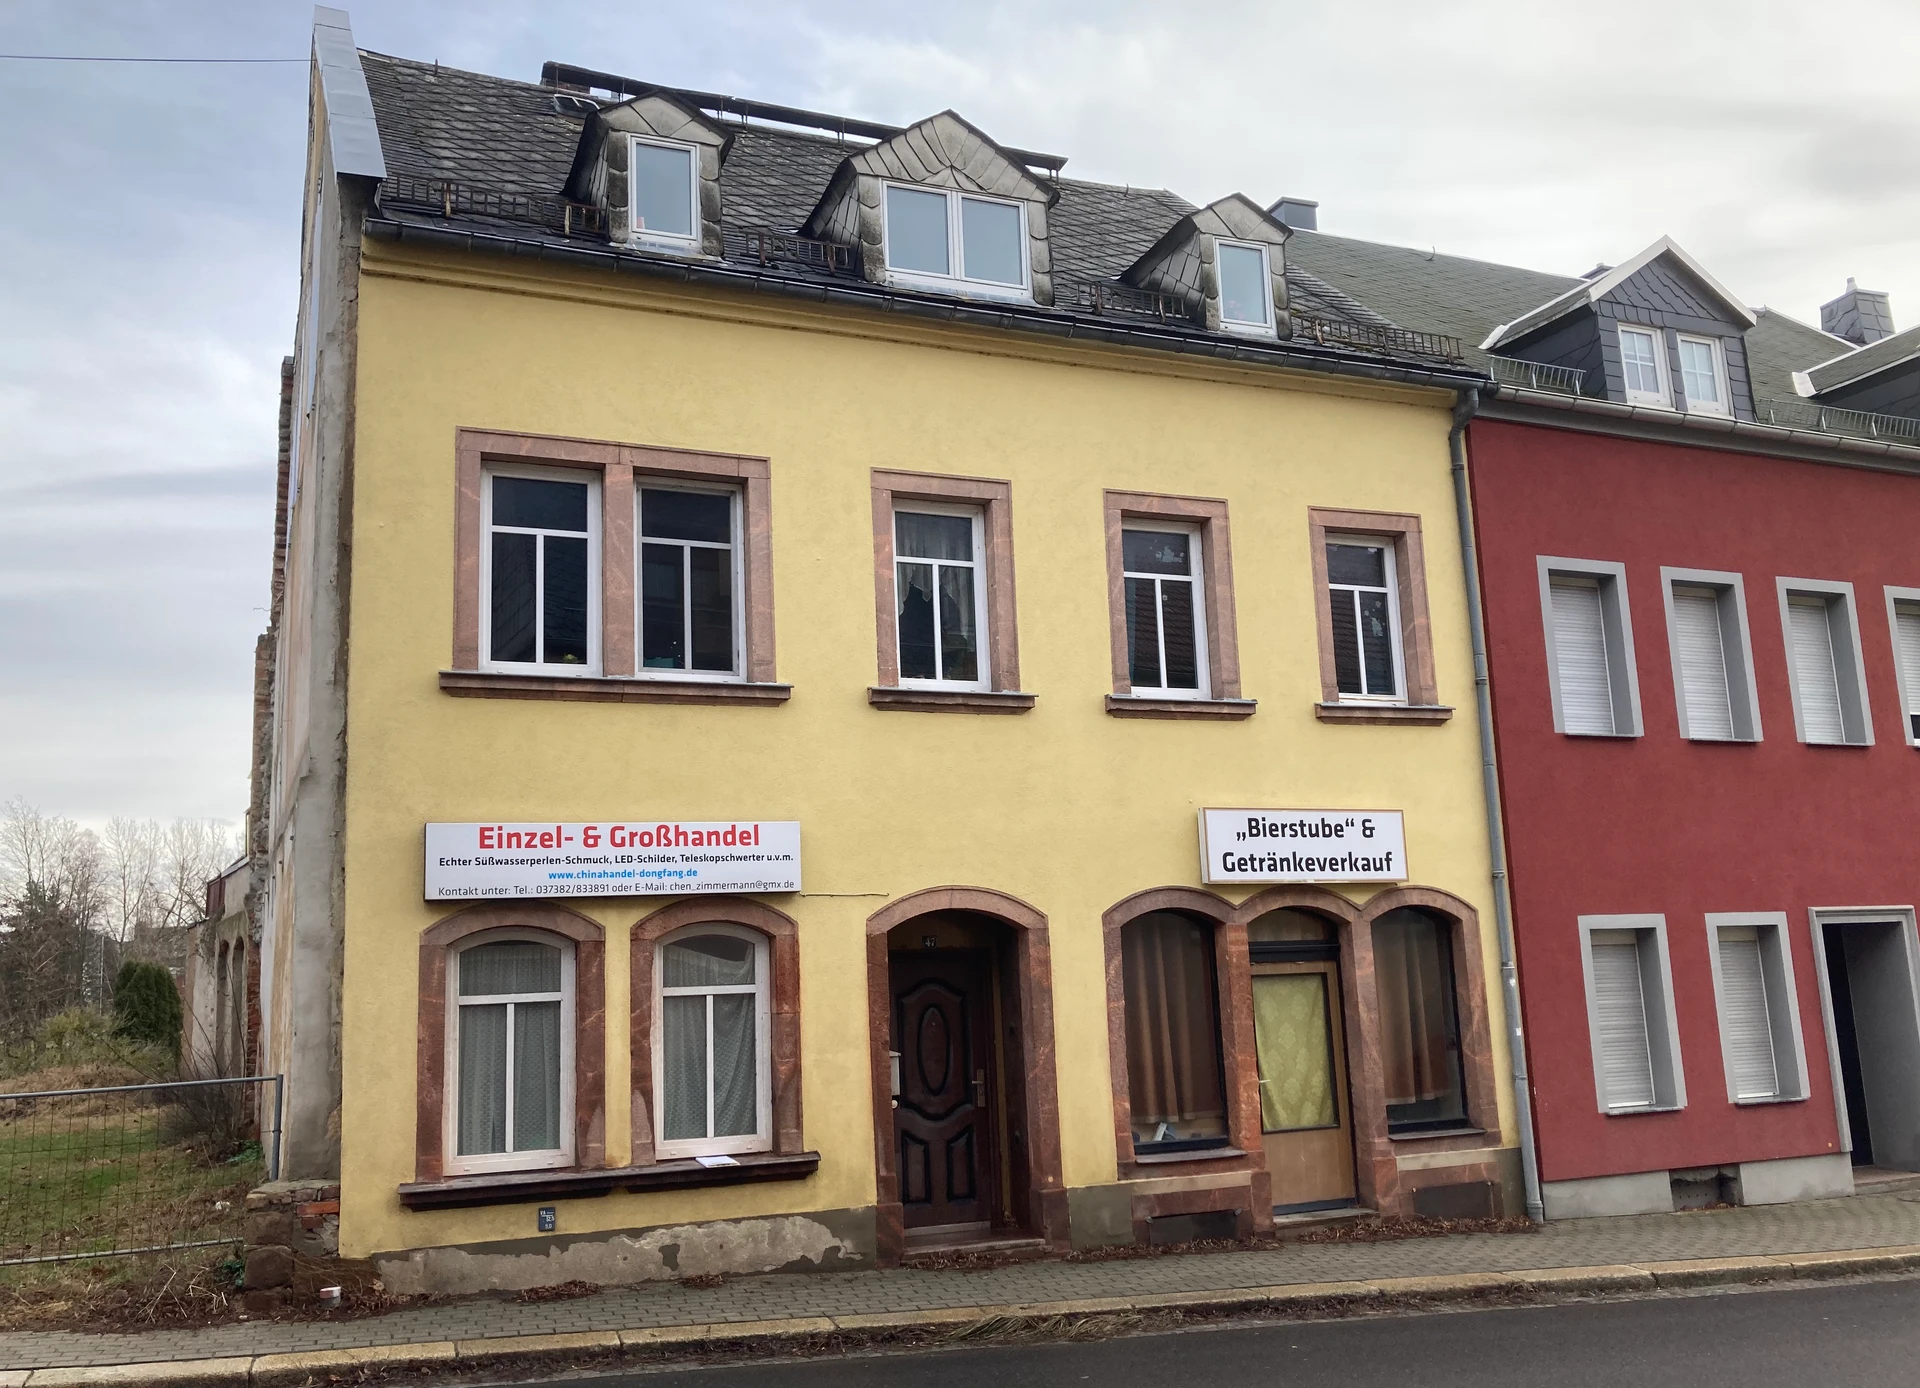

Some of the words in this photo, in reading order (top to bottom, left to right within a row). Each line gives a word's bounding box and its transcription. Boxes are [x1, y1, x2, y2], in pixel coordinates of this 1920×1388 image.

[479, 826, 573, 849] Einzel-
[583, 826, 602, 848] &
[610, 824, 760, 848] Großhandel
[1361, 818, 1375, 839] &
[439, 857, 472, 867] Echter
[475, 855, 612, 867] Süßwasserperlen-Schmuck,
[615, 854, 678, 864] LED-Schilder,
[680, 853, 765, 864] Teleskopschwerter
[1222, 851, 1393, 873] Getränkeverkauf
[548, 868, 698, 880] www.chinahandel-dongfang.de
[438, 886, 479, 896] Kontakt
[481, 886, 511, 895] unter:
[513, 885, 534, 895] Tel.:
[536, 884, 610, 895] 037382/833891
[611, 883, 632, 892] oder
[635, 882, 668, 891] E-Mail:
[669, 880, 795, 892] chen_zimmermann@gmx.de
[924, 937, 936, 947] 47
